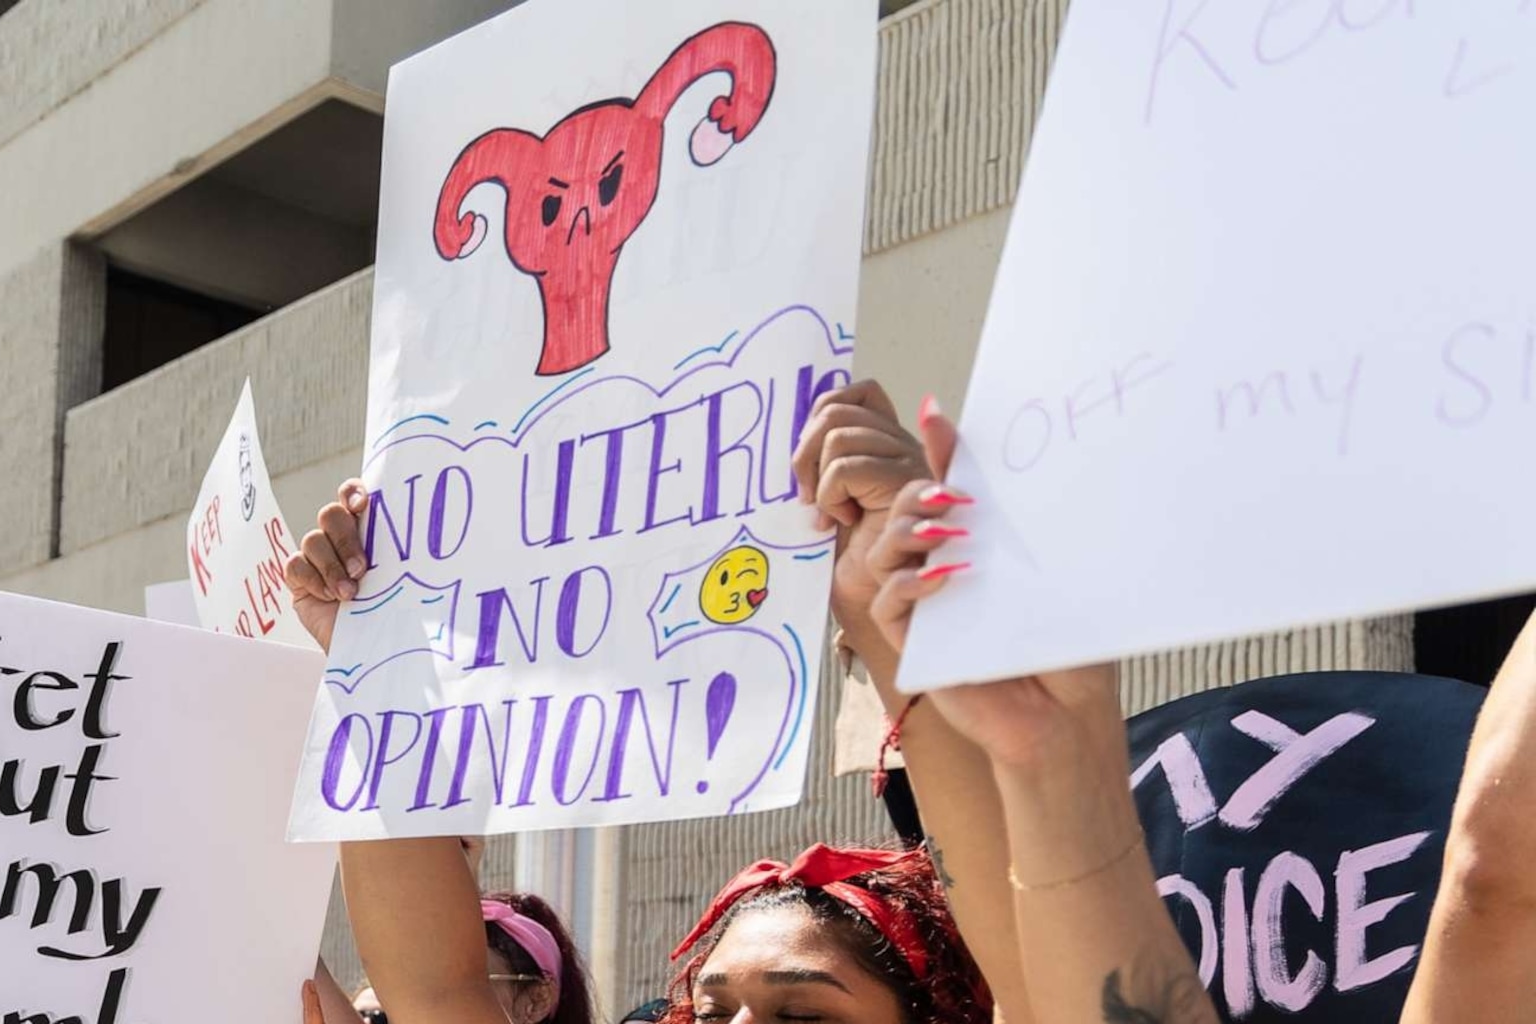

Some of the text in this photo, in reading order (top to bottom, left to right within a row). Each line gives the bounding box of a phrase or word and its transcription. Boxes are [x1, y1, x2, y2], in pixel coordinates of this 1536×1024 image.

[364, 464, 474, 572] NO
[462, 563, 614, 672] NO
[318, 670, 739, 815] OPINION!
